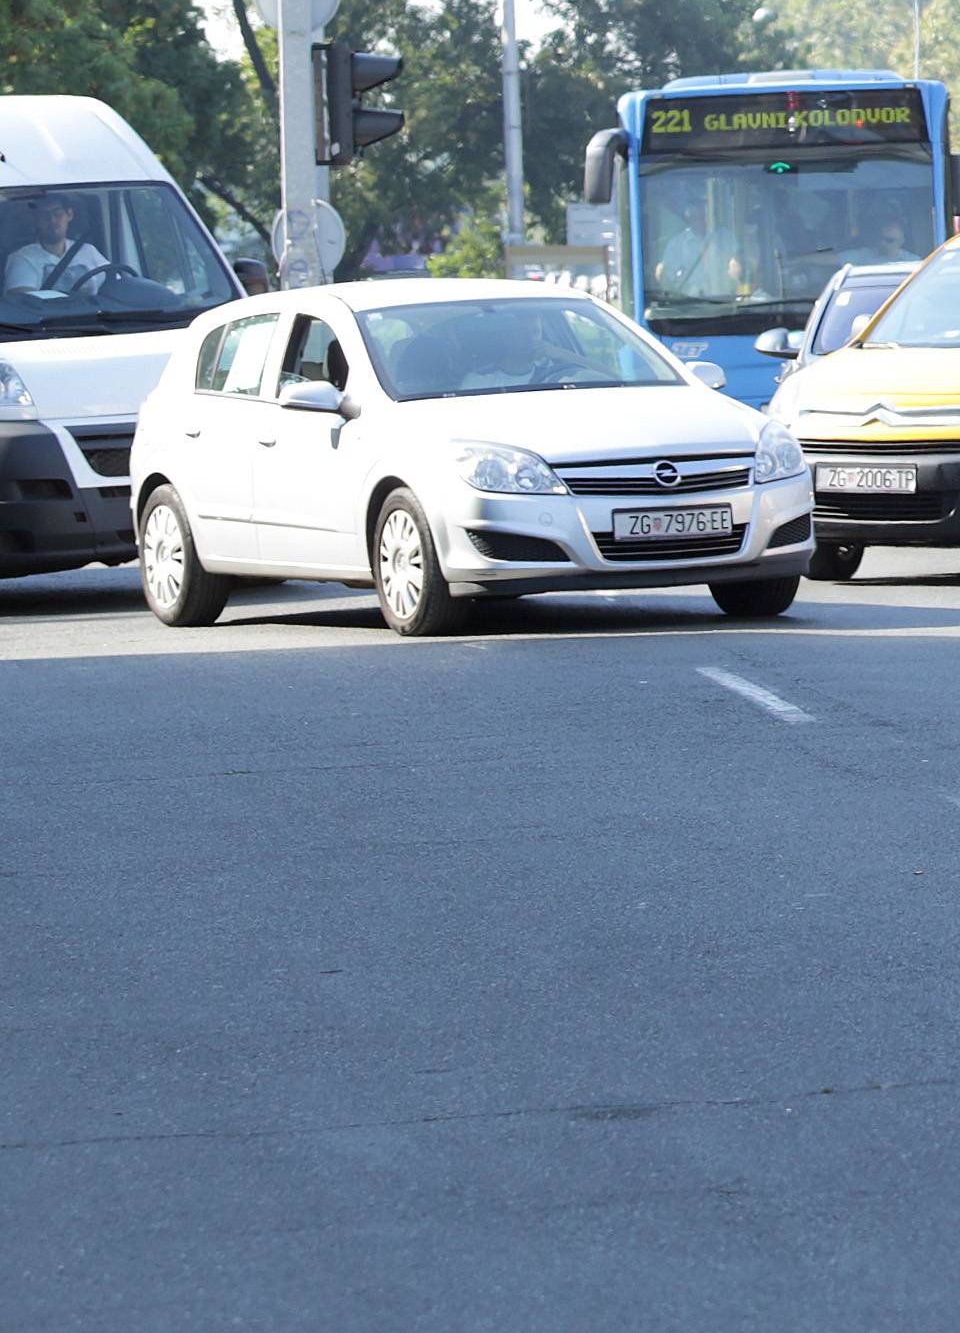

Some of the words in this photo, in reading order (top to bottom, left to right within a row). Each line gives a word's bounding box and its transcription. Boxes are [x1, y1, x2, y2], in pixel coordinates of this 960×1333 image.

[651, 109, 692, 133] 221
[704, 111, 787, 131] GLAVNI
[793, 107, 911, 128] KOLODVOR
[828, 469, 846, 487] ZG
[629, 515, 651, 535] ZG
